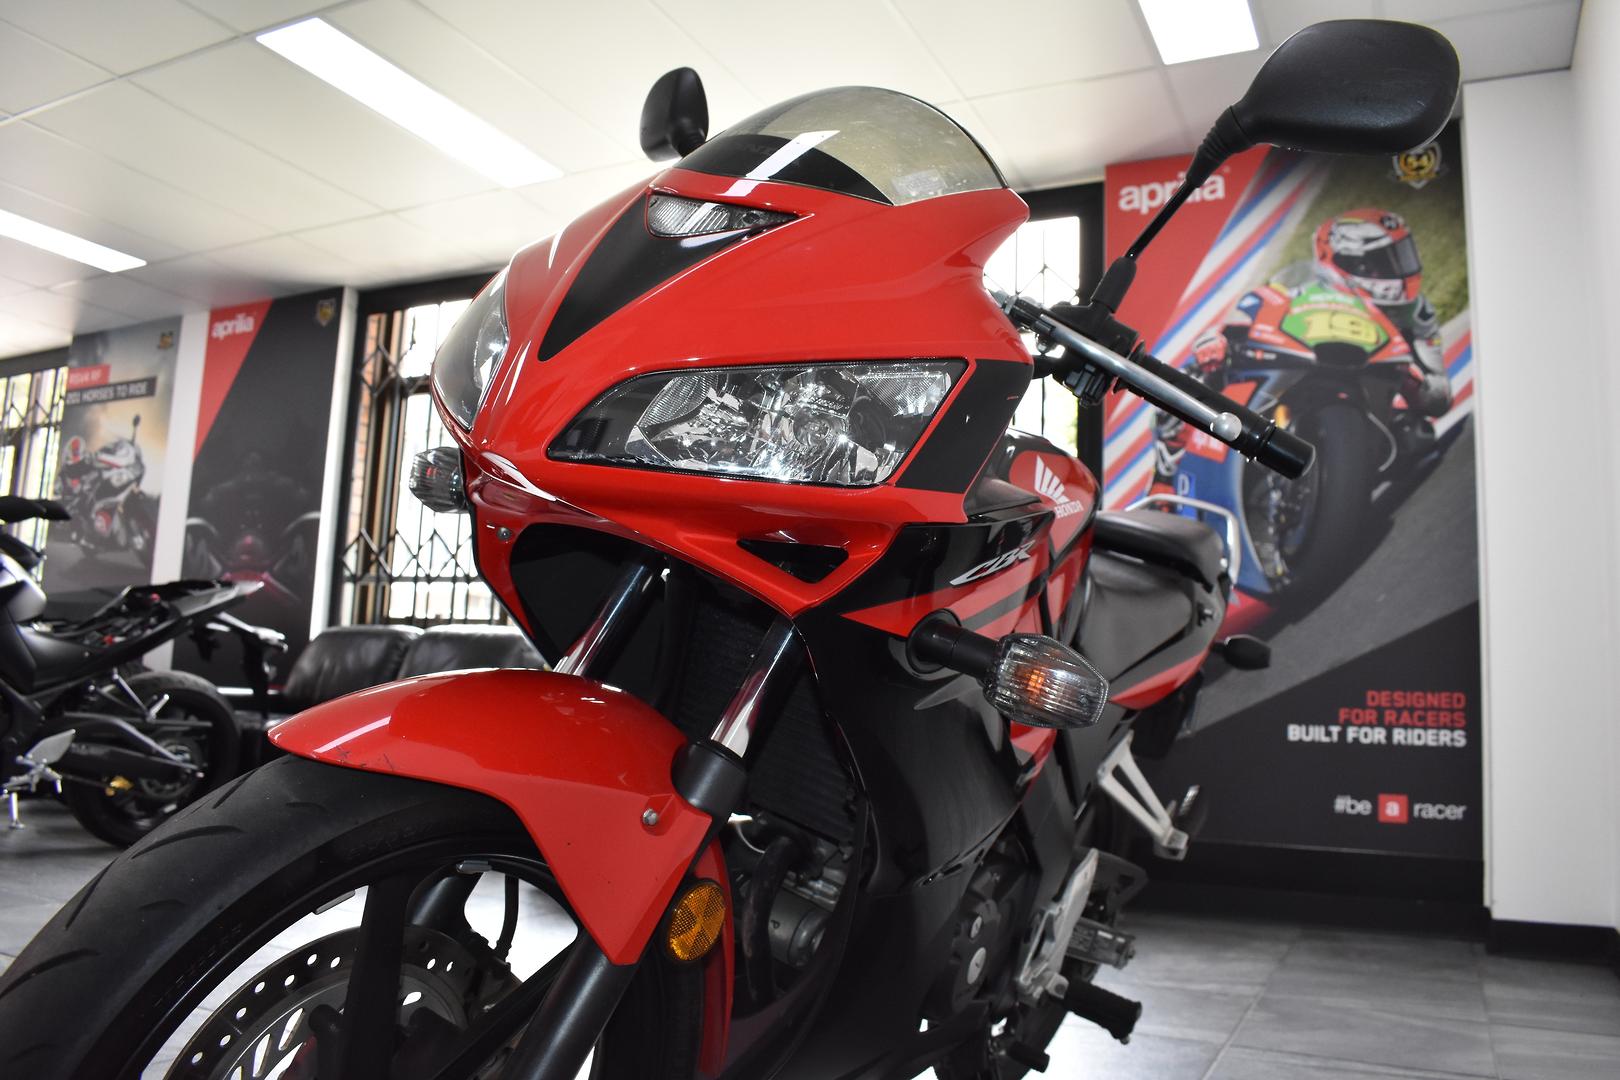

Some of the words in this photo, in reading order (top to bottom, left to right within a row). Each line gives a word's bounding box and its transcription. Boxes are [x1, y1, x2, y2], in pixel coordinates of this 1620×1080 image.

[1054, 500, 1084, 519] HONDA
[1367, 690, 1466, 709] DESIGNED
[1339, 708, 1377, 726] FOR
[1384, 709, 1466, 728] RACERS
[1287, 723, 1341, 743] BUILT
[1347, 725, 1386, 744] FOR
[1392, 727, 1467, 747] RIDERS
[1333, 795, 1372, 815] #be
[1413, 802, 1467, 820] racer
